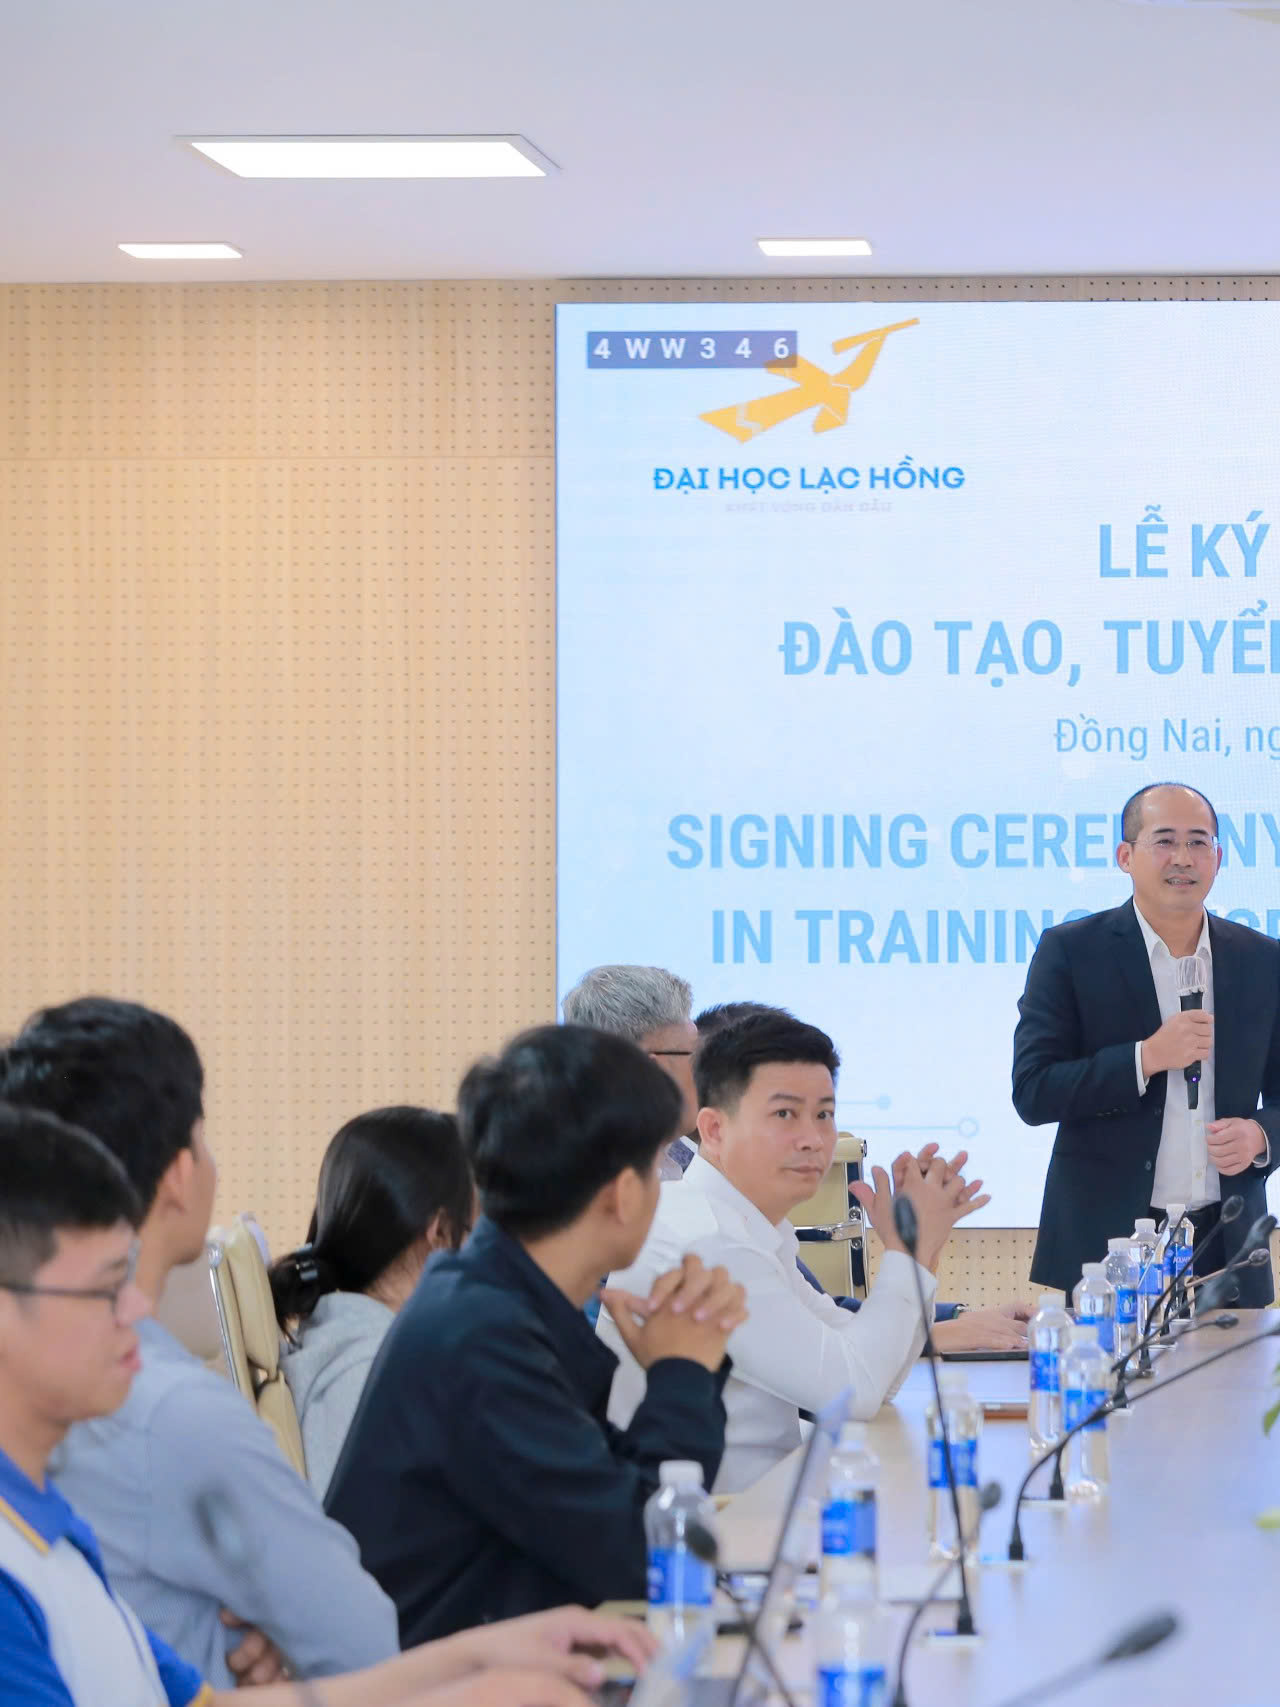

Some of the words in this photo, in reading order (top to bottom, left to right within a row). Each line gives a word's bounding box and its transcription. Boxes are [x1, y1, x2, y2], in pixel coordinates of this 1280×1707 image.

[653, 467, 710, 495] ĐẠI
[718, 467, 791, 495] HỌC
[800, 467, 861, 495] LẠC
[869, 455, 966, 490] HỒNG
[1099, 504, 1169, 578] LỄ
[1191, 509, 1270, 578] KÝ
[778, 607, 913, 676] ĐÀO
[934, 619, 1081, 688] TẠO,
[1054, 713, 1148, 761] Đồng
[1163, 716, 1232, 758] Nai,
[667, 813, 928, 870] SIGNING
[712, 909, 772, 964] IN
[794, 908, 1094, 964] TRAININ
